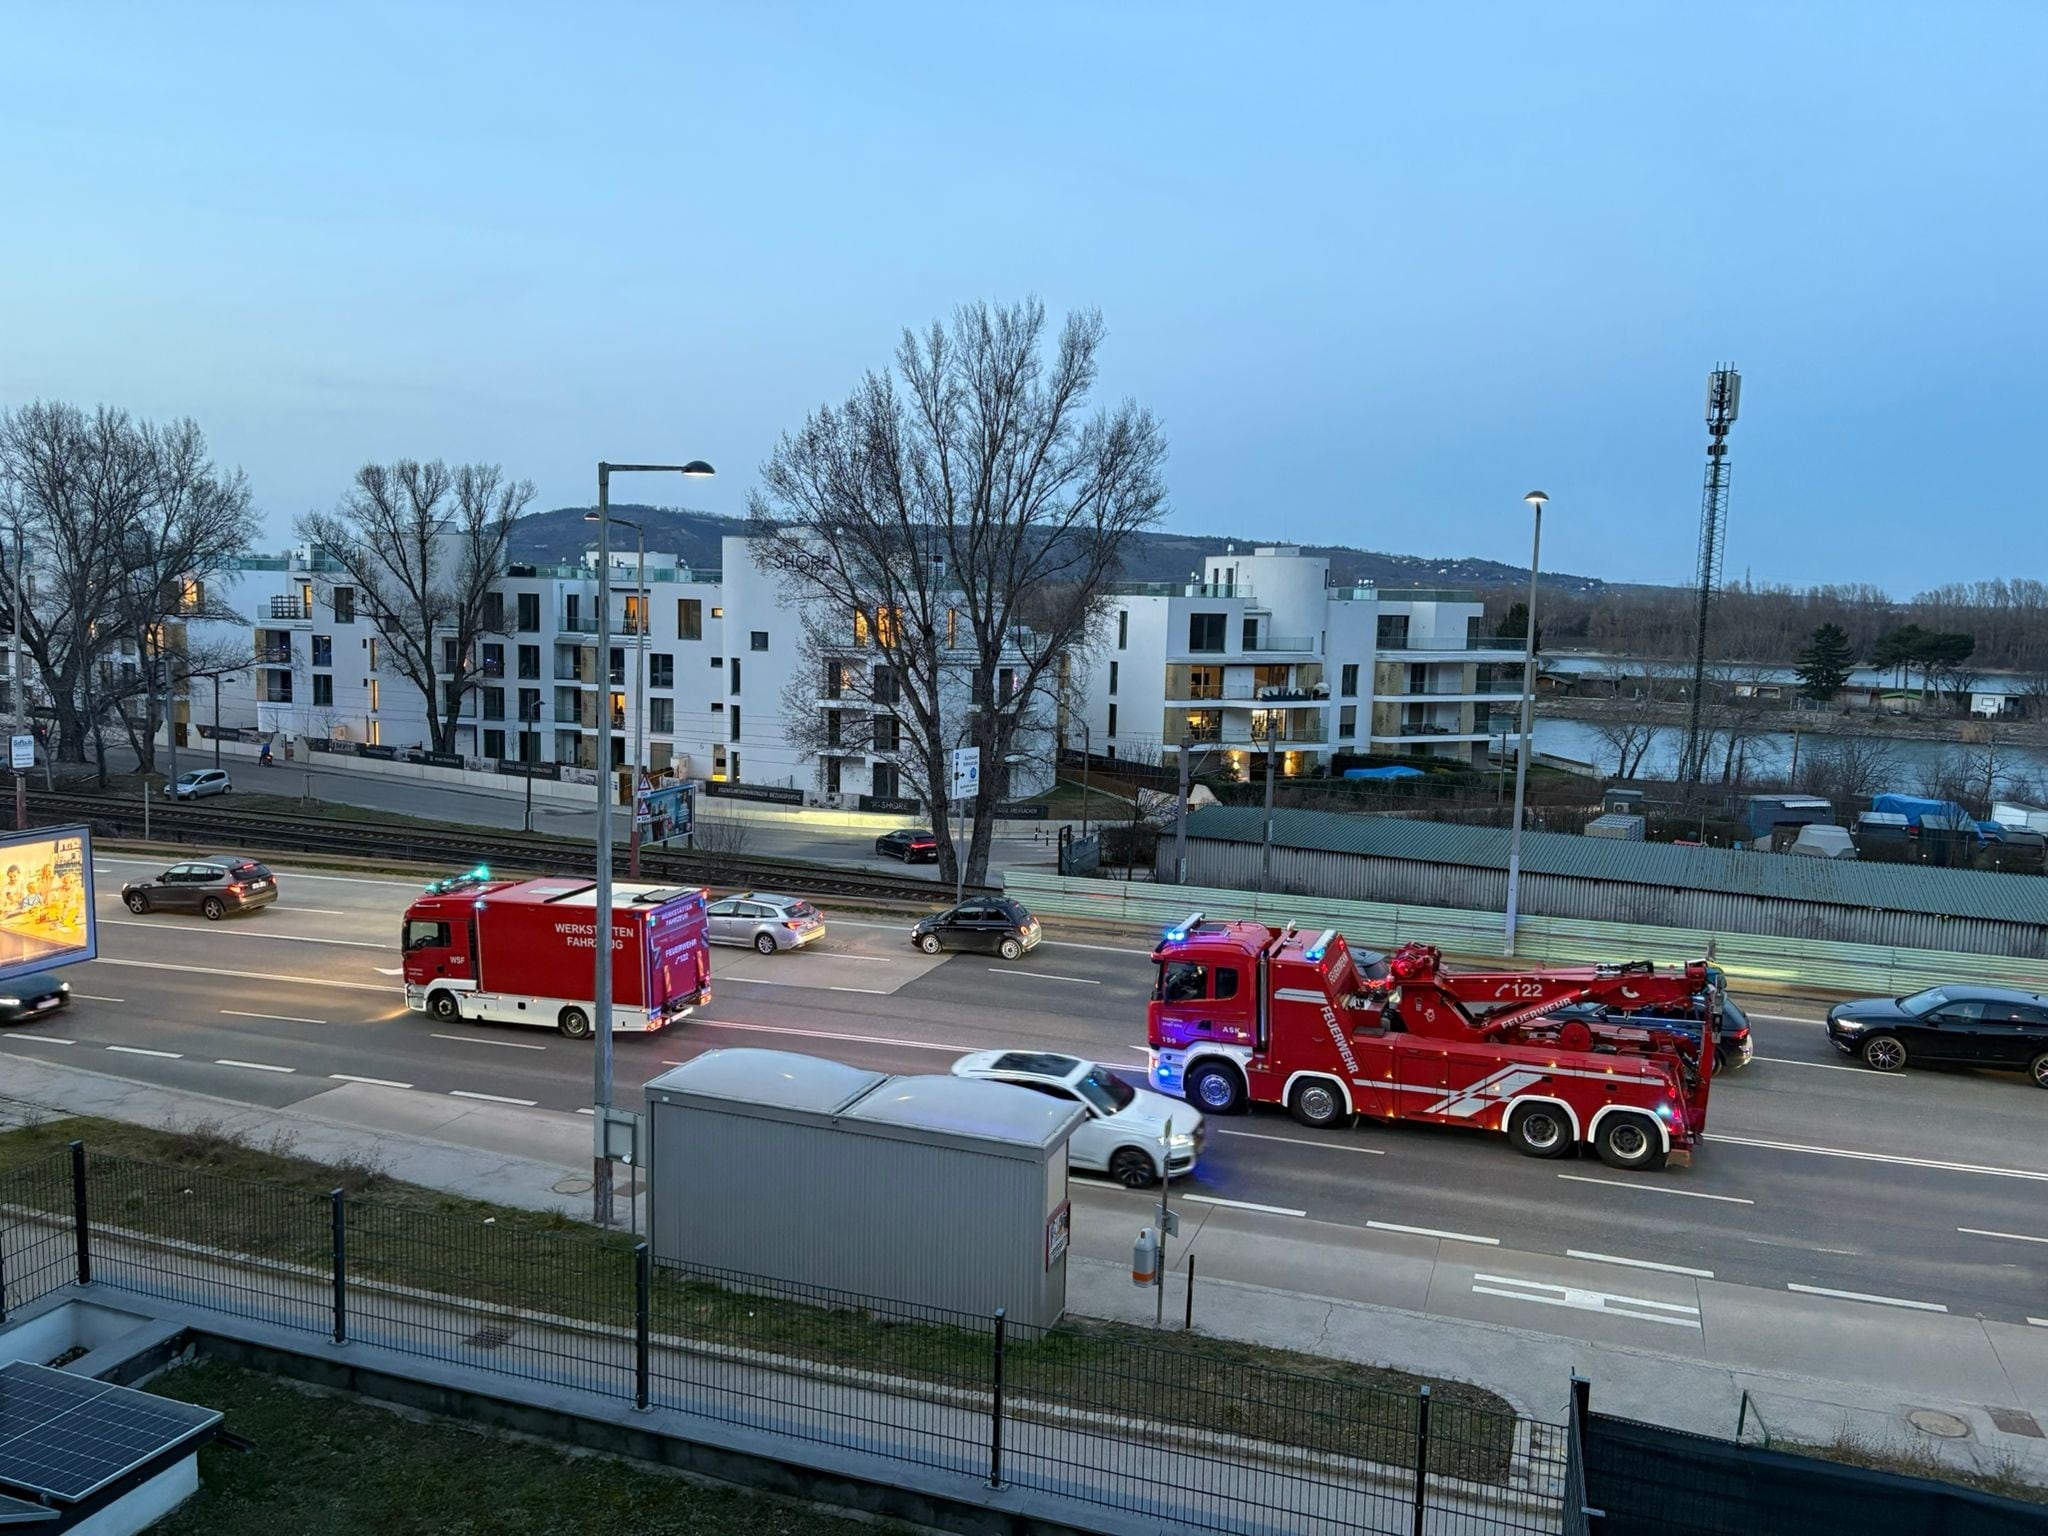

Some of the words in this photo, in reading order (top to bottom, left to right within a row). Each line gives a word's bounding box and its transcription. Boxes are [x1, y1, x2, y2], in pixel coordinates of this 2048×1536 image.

[555, 922, 634, 938] WERKSTTEN
[665, 938, 697, 957] FEUERWEHR
[449, 956, 465, 964] WSF
[1511, 983, 1543, 997] 122
[1501, 997, 1572, 1029] FEUERWEHR
[1321, 1005, 1359, 1074] FEUERWEHR
